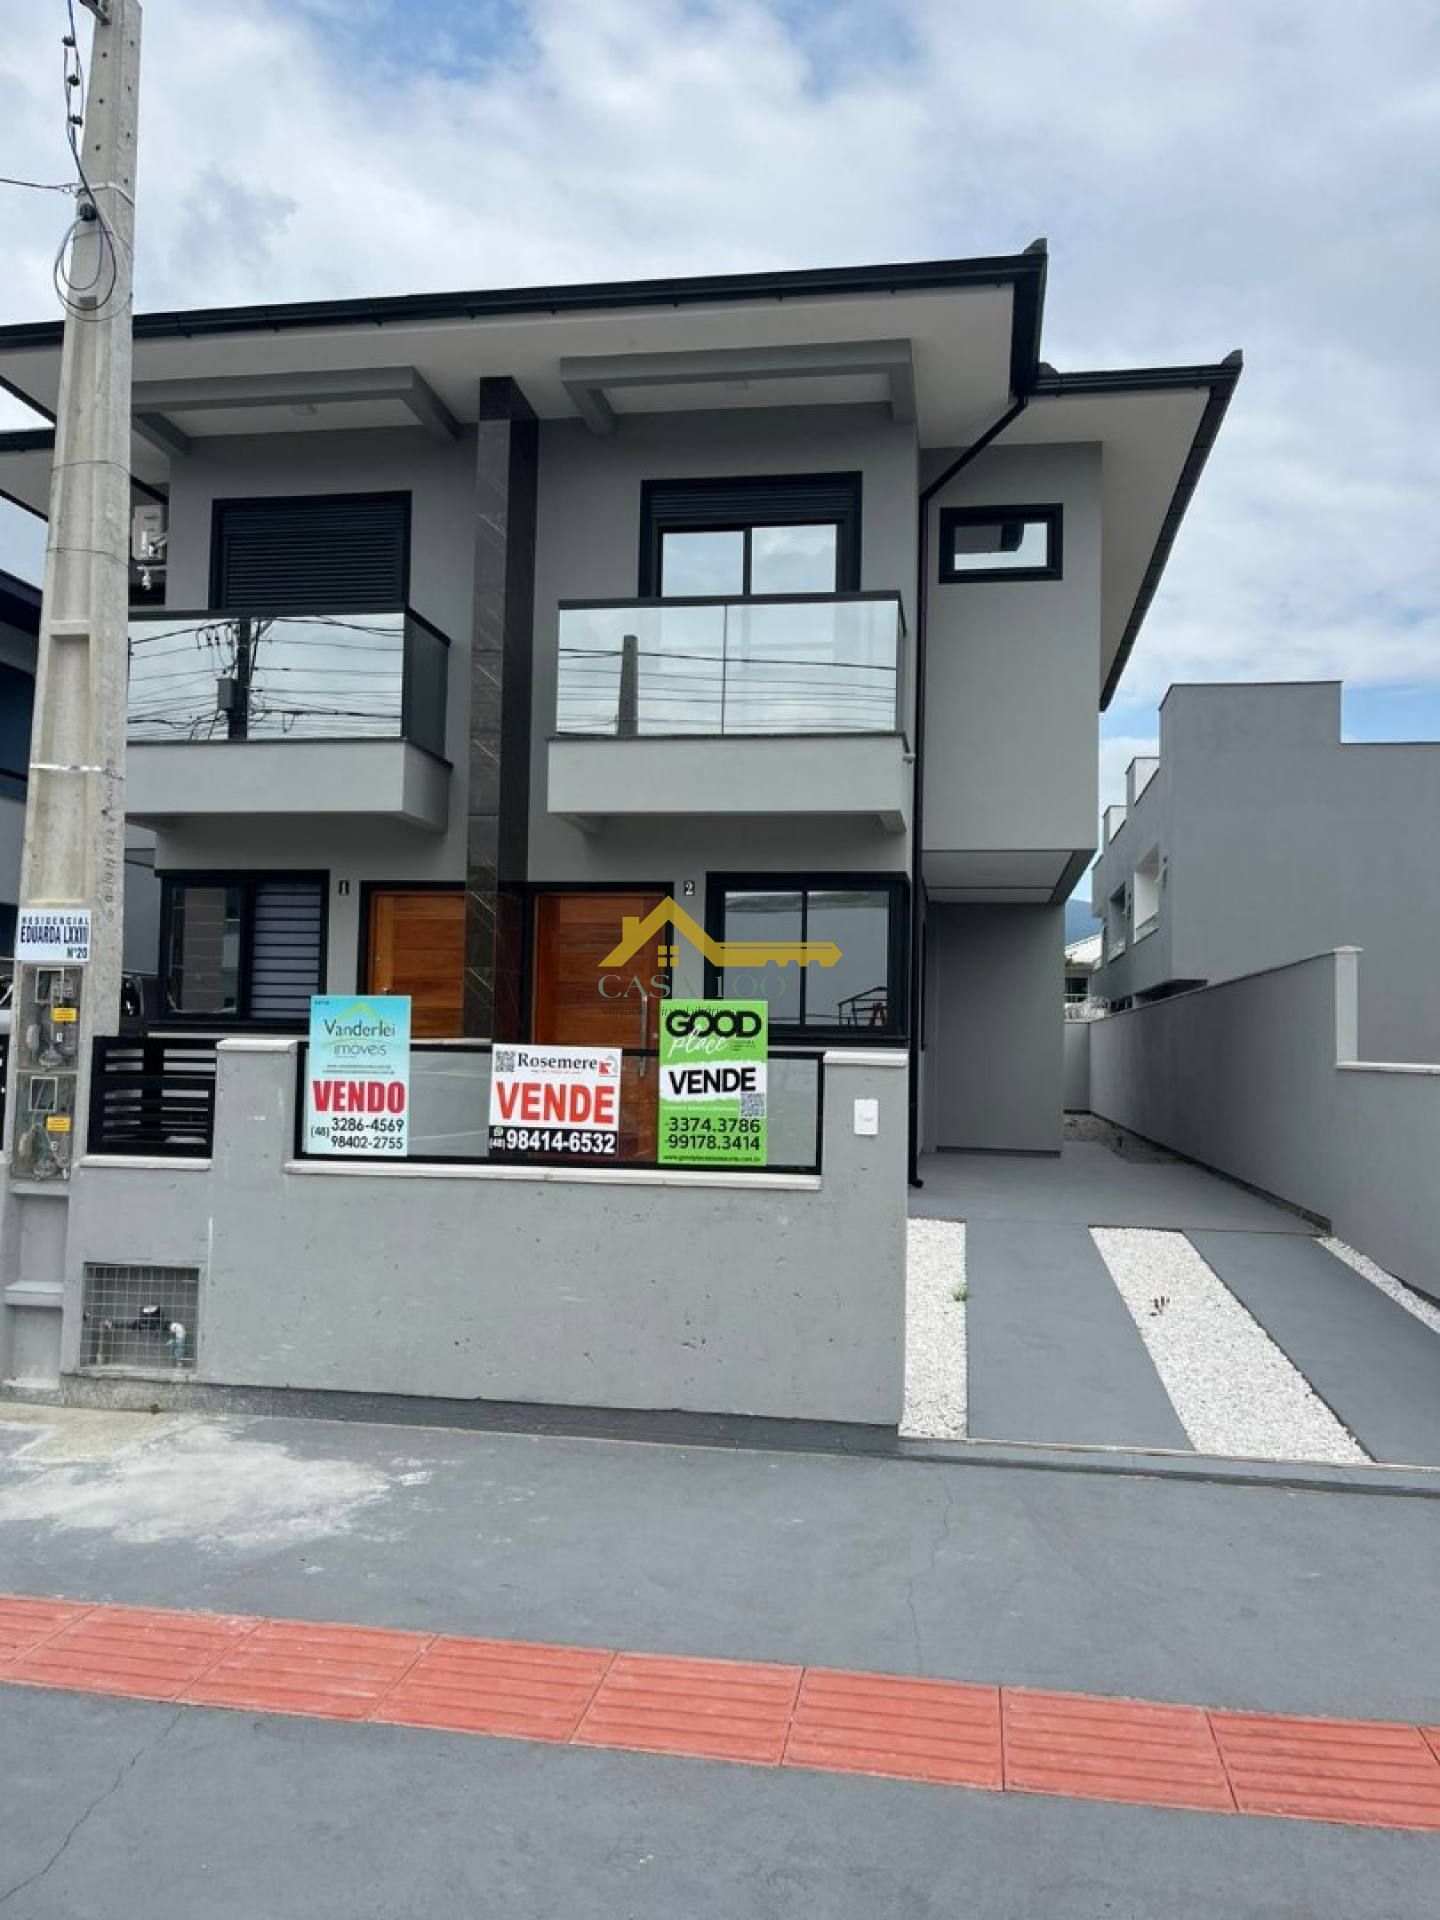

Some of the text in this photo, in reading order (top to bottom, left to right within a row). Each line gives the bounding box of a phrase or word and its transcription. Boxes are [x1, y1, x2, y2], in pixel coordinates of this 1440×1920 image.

[684, 880, 695, 896] 2
[22, 916, 88, 925] RESIDENCIAL
[21, 926, 61, 944] EDUARDA
[323, 1019, 396, 1037] Vanderlei
[665, 1009, 762, 1038] GOOD
[668, 1025, 727, 1058] place
[518, 1052, 598, 1070] Rosemere
[668, 1066, 757, 1095] VENDE
[312, 1080, 405, 1114] VENDO
[495, 1080, 615, 1125] VENDE
[310, 1126, 330, 1138] (48)
[331, 1117, 405, 1133] 3286-4569
[668, 1116, 761, 1133] 3374.3786
[330, 1135, 403, 1149] 98402-2755
[506, 1128, 616, 1154] 98414-6532
[668, 1134, 760, 1151] 99178.3414
